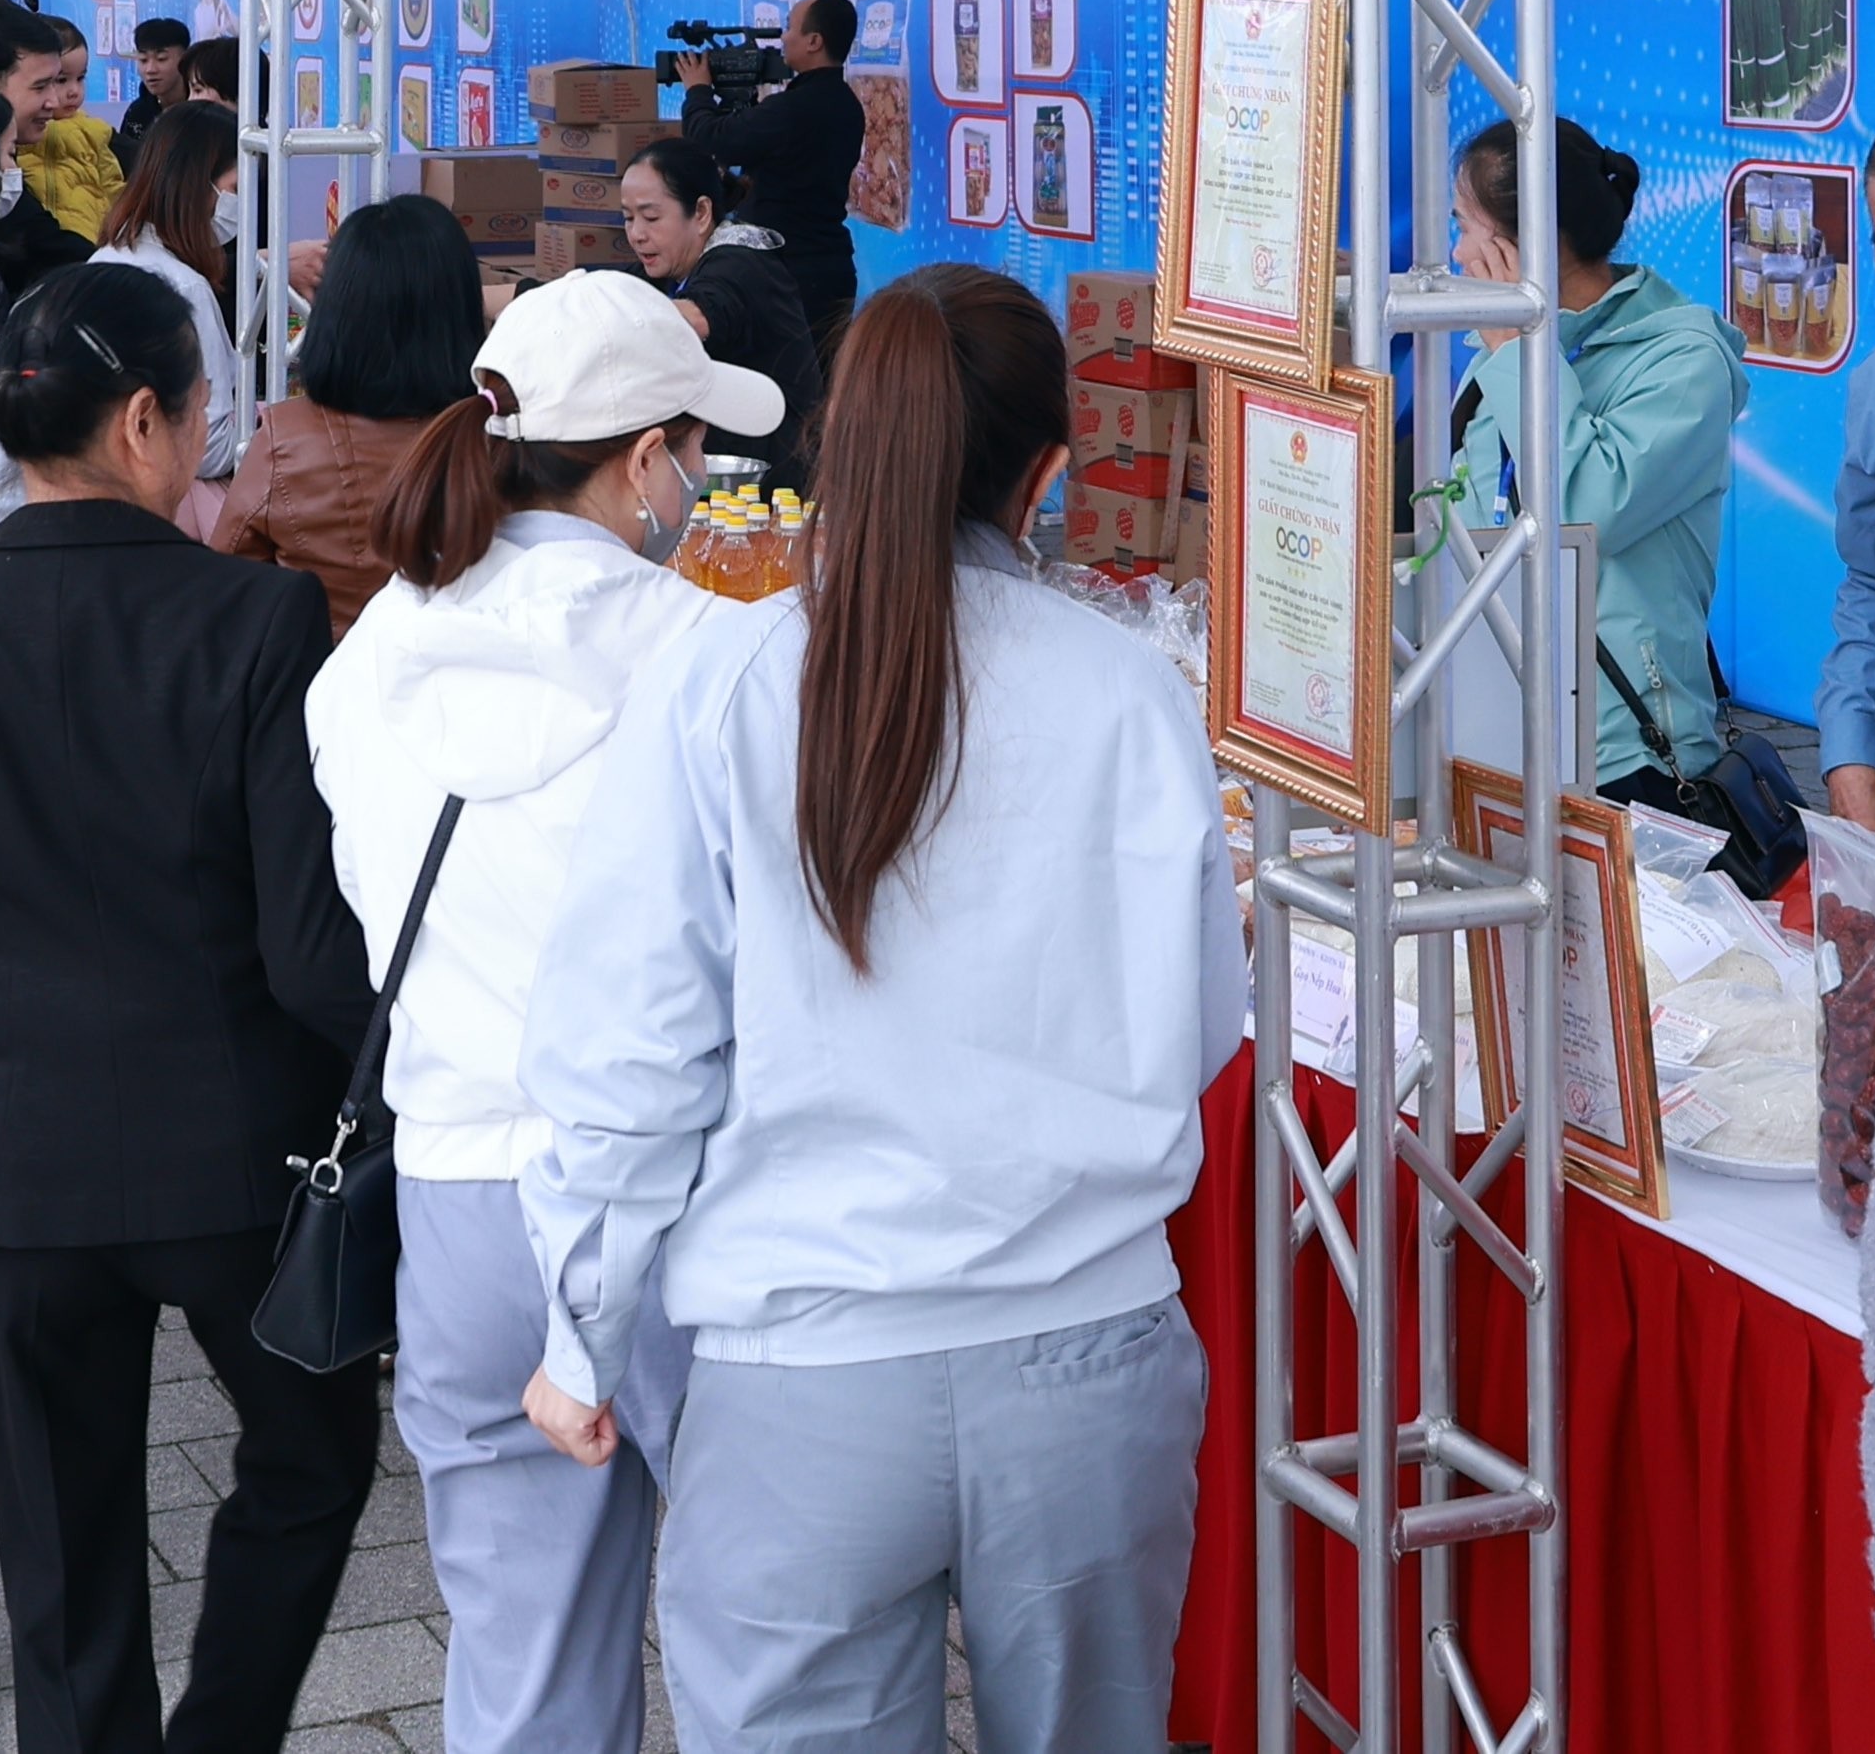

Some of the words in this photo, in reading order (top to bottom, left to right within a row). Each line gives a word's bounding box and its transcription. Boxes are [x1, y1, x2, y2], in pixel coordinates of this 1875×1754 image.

[1226, 106, 1271, 134] OCOP
[1258, 497, 1279, 515] GIẤY
[1280, 504, 1312, 527] CHỨNG
[1314, 515, 1341, 536] NHẬN
[1276, 526, 1323, 560] OCOP
[1293, 965, 1309, 982] Gạo
[1310, 970, 1325, 991] Nếp
[1326, 979, 1342, 996] Hoa
